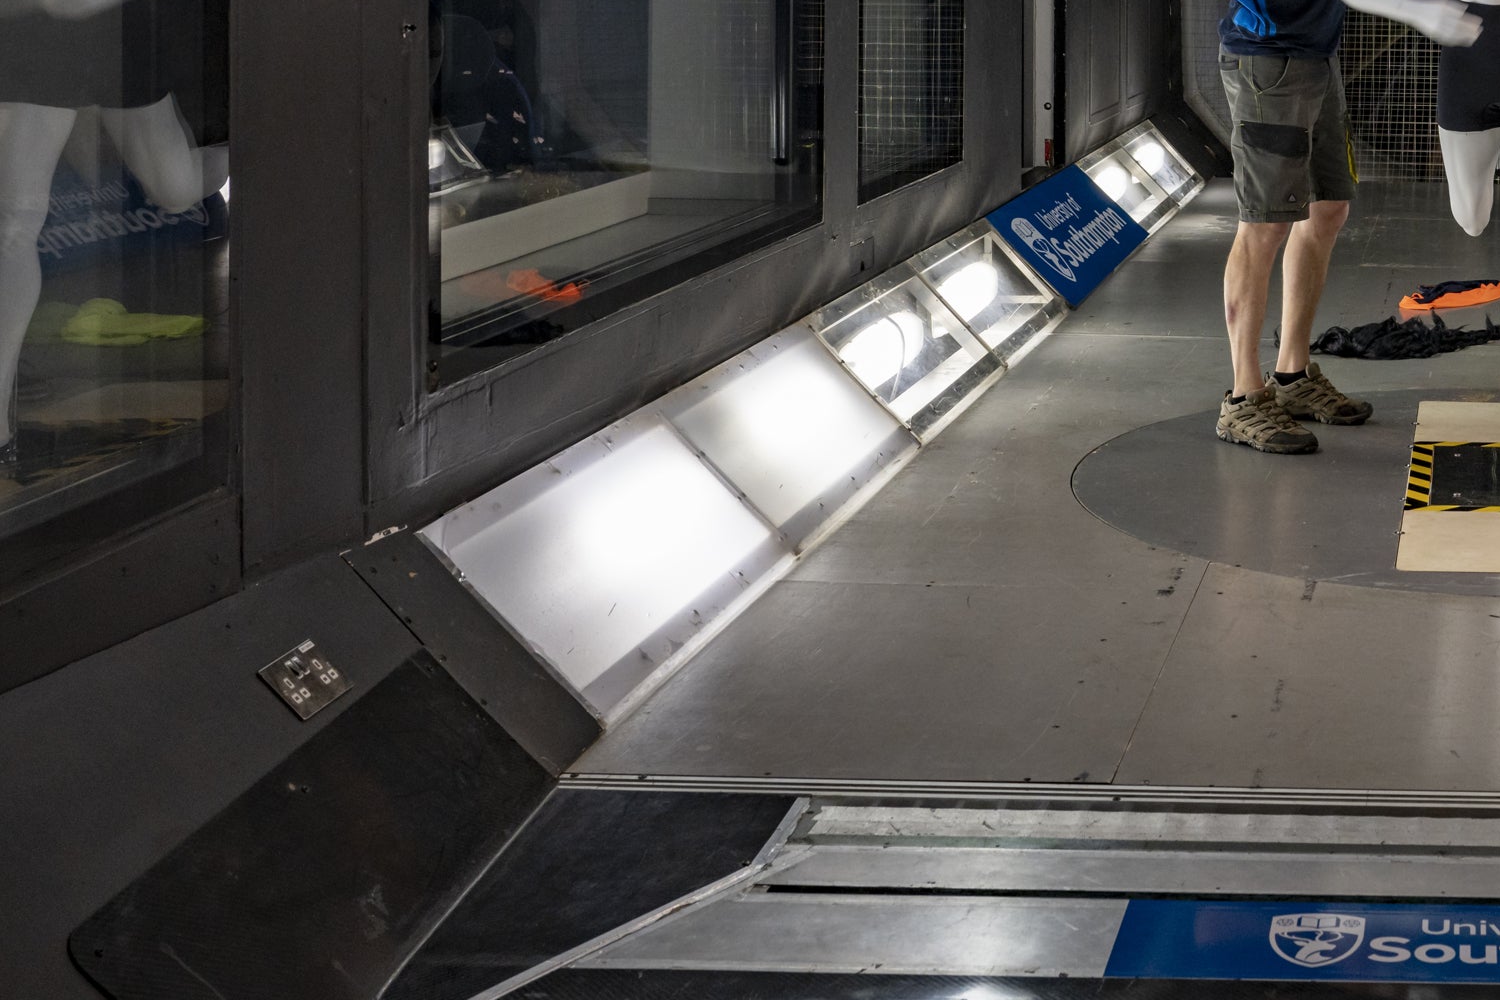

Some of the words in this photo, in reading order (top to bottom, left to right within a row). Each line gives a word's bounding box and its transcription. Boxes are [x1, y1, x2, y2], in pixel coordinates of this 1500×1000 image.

[1034, 200, 1079, 230] University
[1066, 192, 1082, 212] of
[1050, 207, 1127, 268] Southampton
